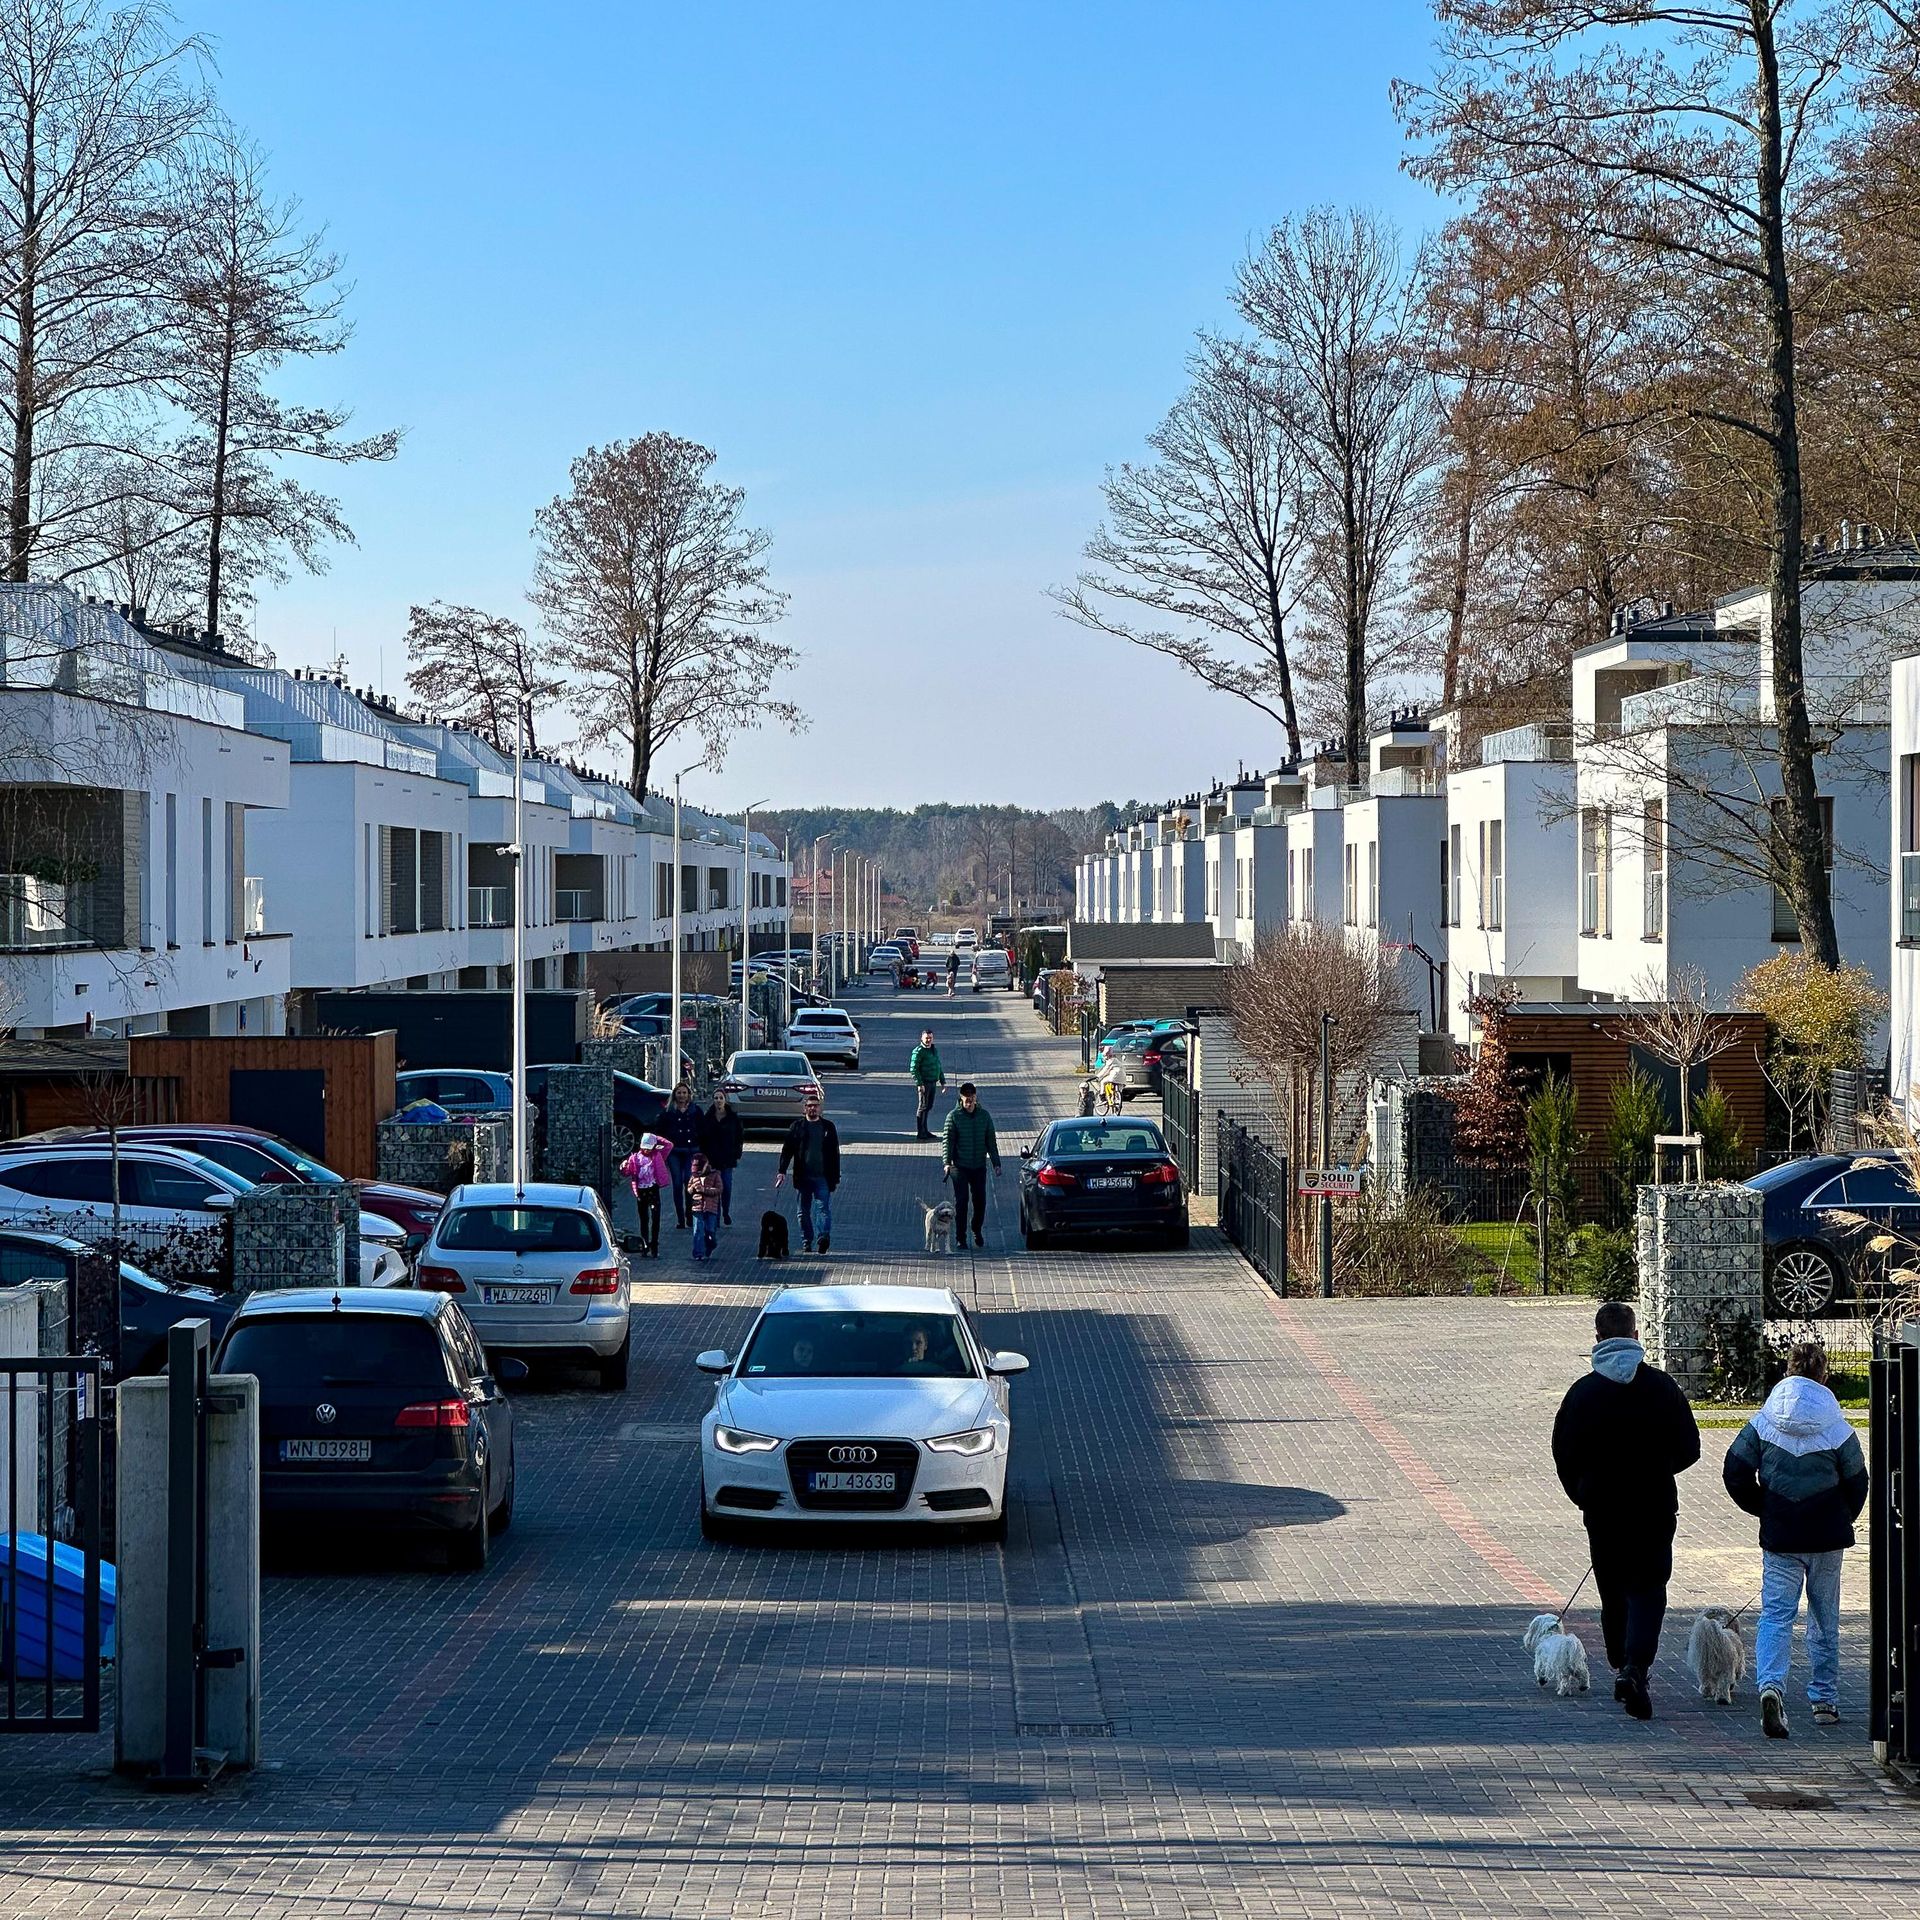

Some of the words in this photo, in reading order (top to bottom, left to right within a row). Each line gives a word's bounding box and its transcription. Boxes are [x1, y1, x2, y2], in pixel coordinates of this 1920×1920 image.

[1321, 1173, 1355, 1183] SOLID
[493, 1289, 508, 1300] WA
[512, 1289, 548, 1300] 7226H
[289, 1441, 313, 1457] WN
[318, 1441, 369, 1457] 0398H
[819, 1474, 839, 1489] WJ
[846, 1474, 893, 1489] 4363G
